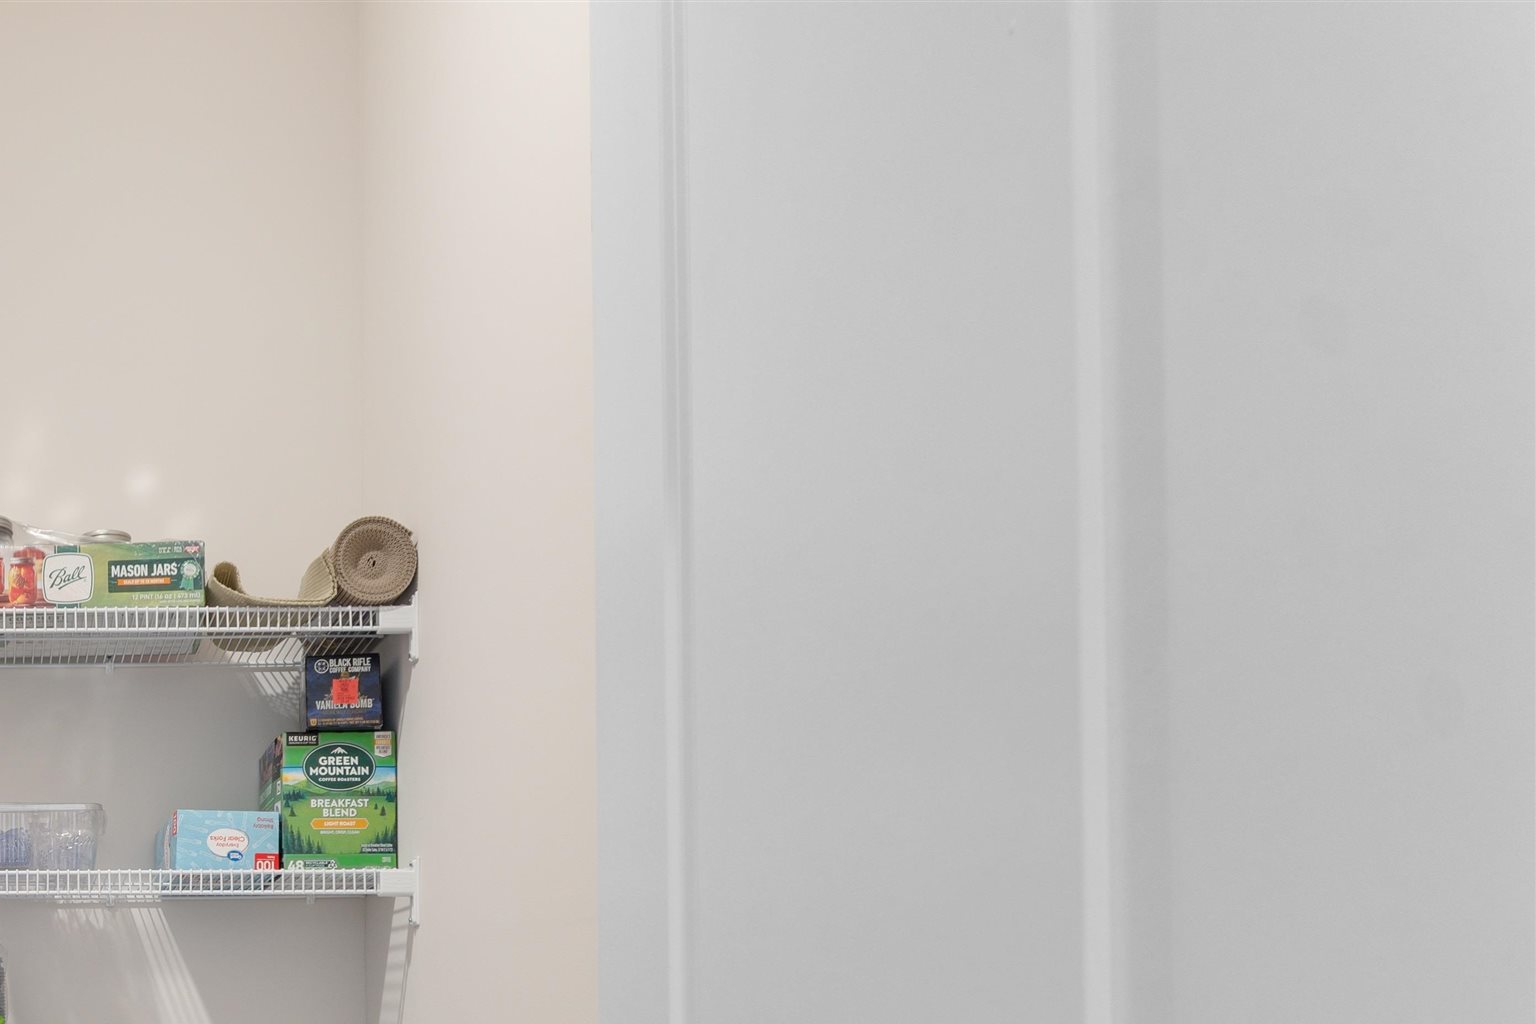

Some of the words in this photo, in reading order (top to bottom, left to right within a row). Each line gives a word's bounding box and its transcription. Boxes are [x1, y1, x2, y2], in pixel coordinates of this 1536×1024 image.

[111, 564, 148, 577] MASON
[49, 565, 87, 590] Ball
[329, 658, 351, 667] BLACK
[352, 657, 372, 666] RIFLE
[318, 756, 359, 766] GREEN
[309, 766, 369, 776] MOUNTAIN
[310, 798, 369, 808] BREAKFAST
[322, 808, 357, 817] BLEND
[256, 860, 275, 870] 100
[287, 860, 305, 870] 48
